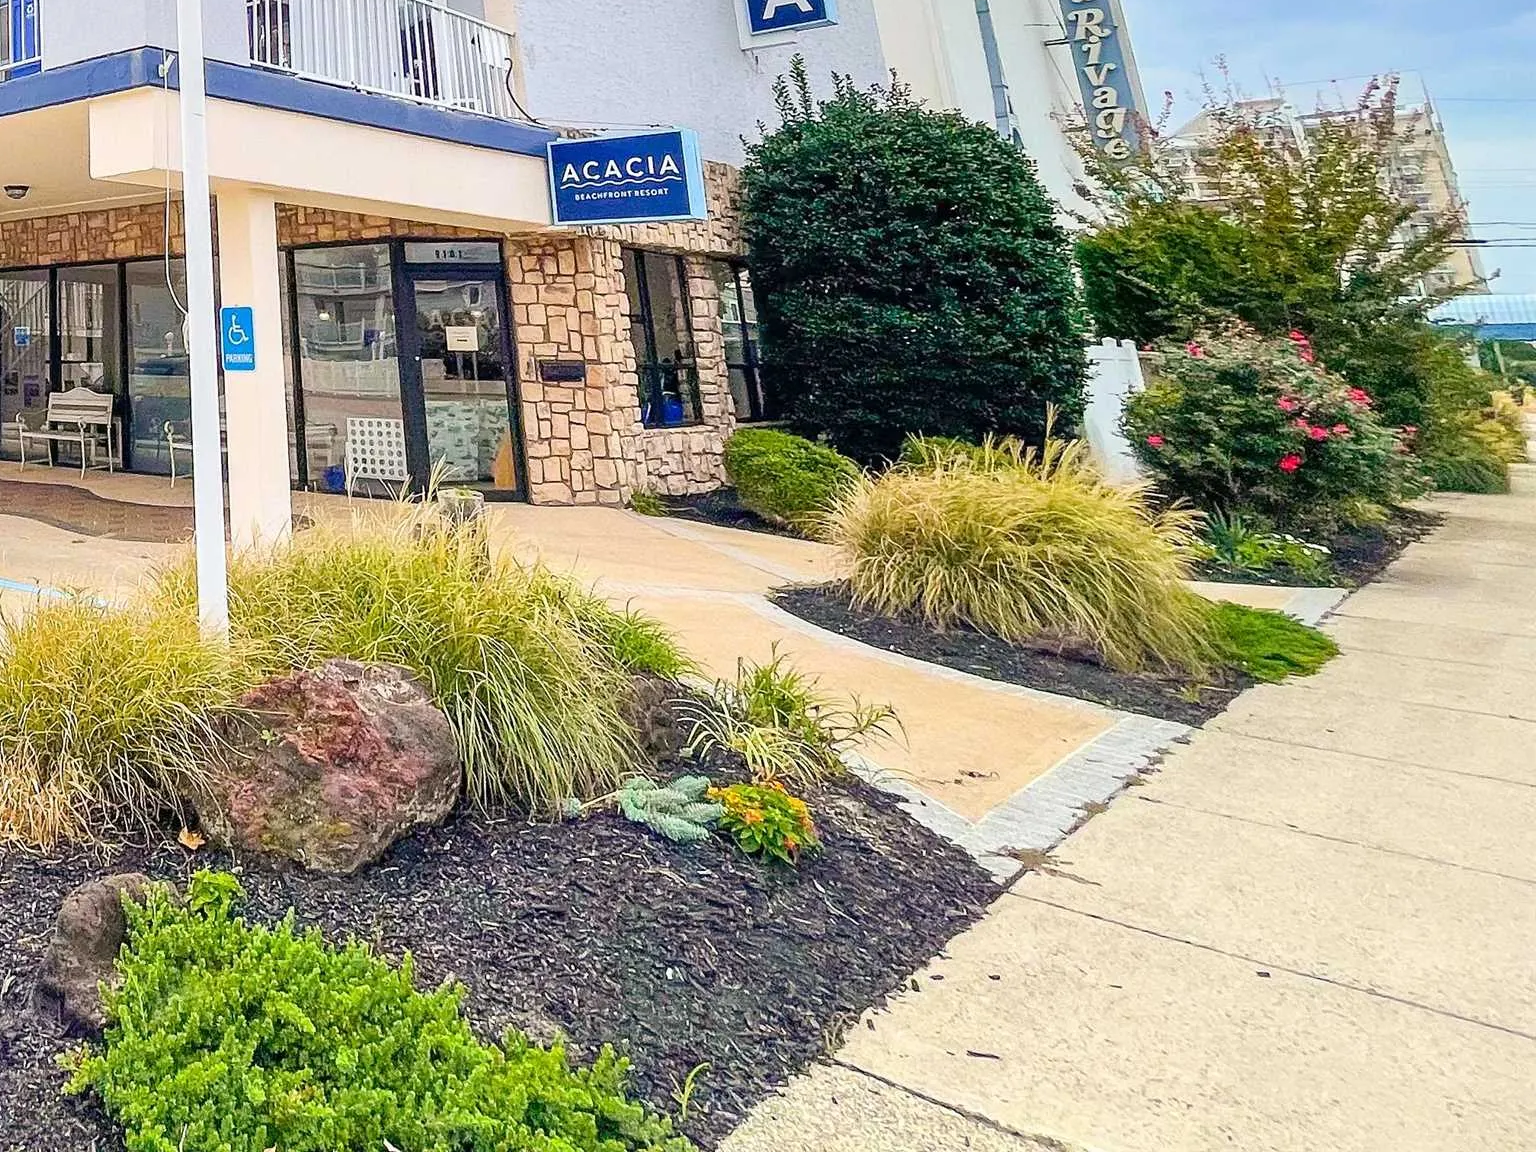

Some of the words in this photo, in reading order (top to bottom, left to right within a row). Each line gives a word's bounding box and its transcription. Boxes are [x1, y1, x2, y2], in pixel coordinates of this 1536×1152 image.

[1068, 8, 1131, 160] Rivage
[561, 154, 680, 183] ACACIA
[575, 190, 633, 201] BEACHFRONT
[634, 188, 669, 197] RESORT
